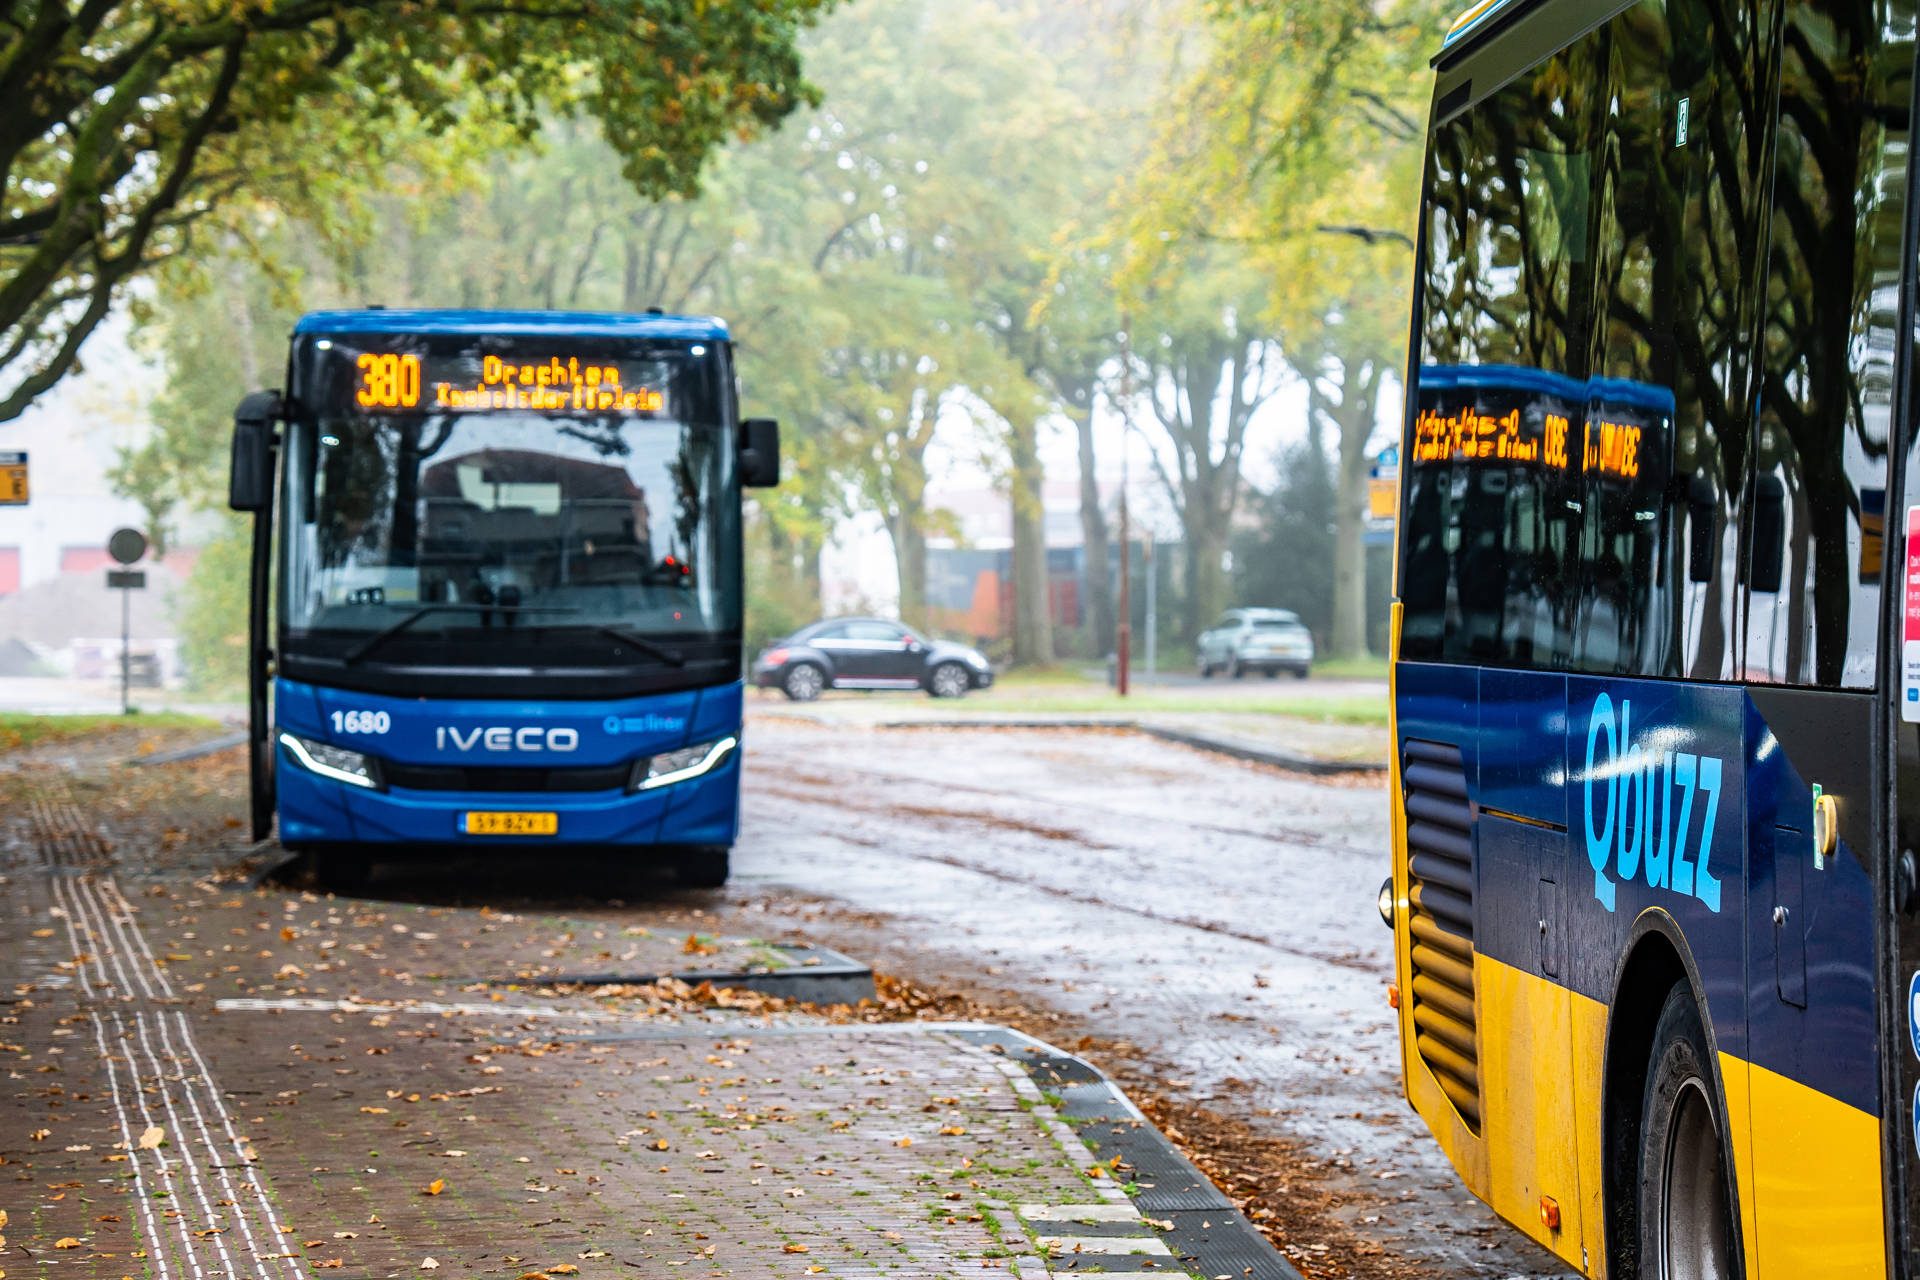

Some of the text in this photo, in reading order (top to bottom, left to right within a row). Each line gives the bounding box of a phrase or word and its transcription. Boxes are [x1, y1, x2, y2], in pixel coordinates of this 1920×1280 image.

[357, 353, 421, 408] 380
[483, 354, 620, 386] Drachten
[331, 710, 391, 734] 1680
[436, 726, 580, 751] IVECO
[1584, 691, 1723, 913] Qbuzz
